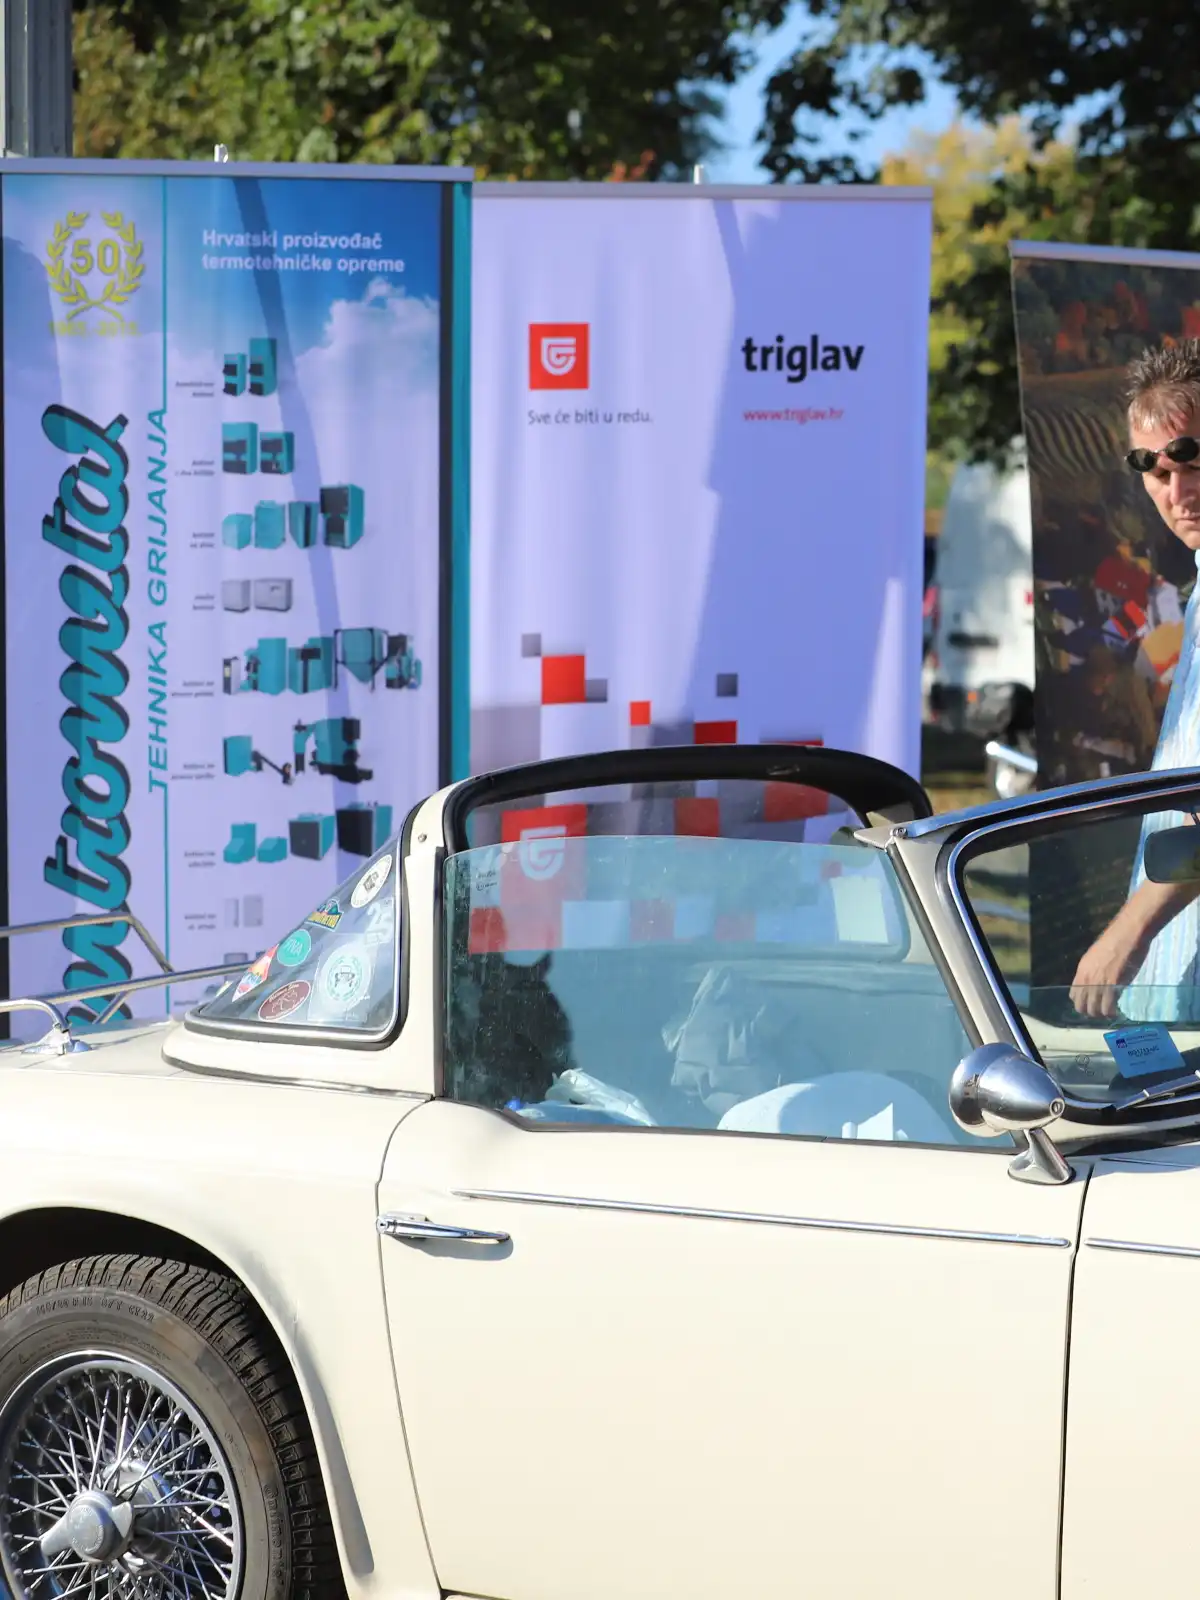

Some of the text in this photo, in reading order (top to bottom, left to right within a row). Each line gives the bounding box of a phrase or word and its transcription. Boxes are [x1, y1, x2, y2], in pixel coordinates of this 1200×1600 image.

[70, 239, 118, 275] 50
[202, 229, 383, 255] Hrvatski proizvođač
[202, 253, 406, 276] termotehničke opreme
[742, 335, 865, 383] triglav
[528, 408, 653, 424] Sve će biti u redu.
[743, 406, 844, 425] www.triglav.hr
[147, 407, 168, 795] TEHNIKA GRIJANJA
[42, 404, 133, 1024] ntrometal
